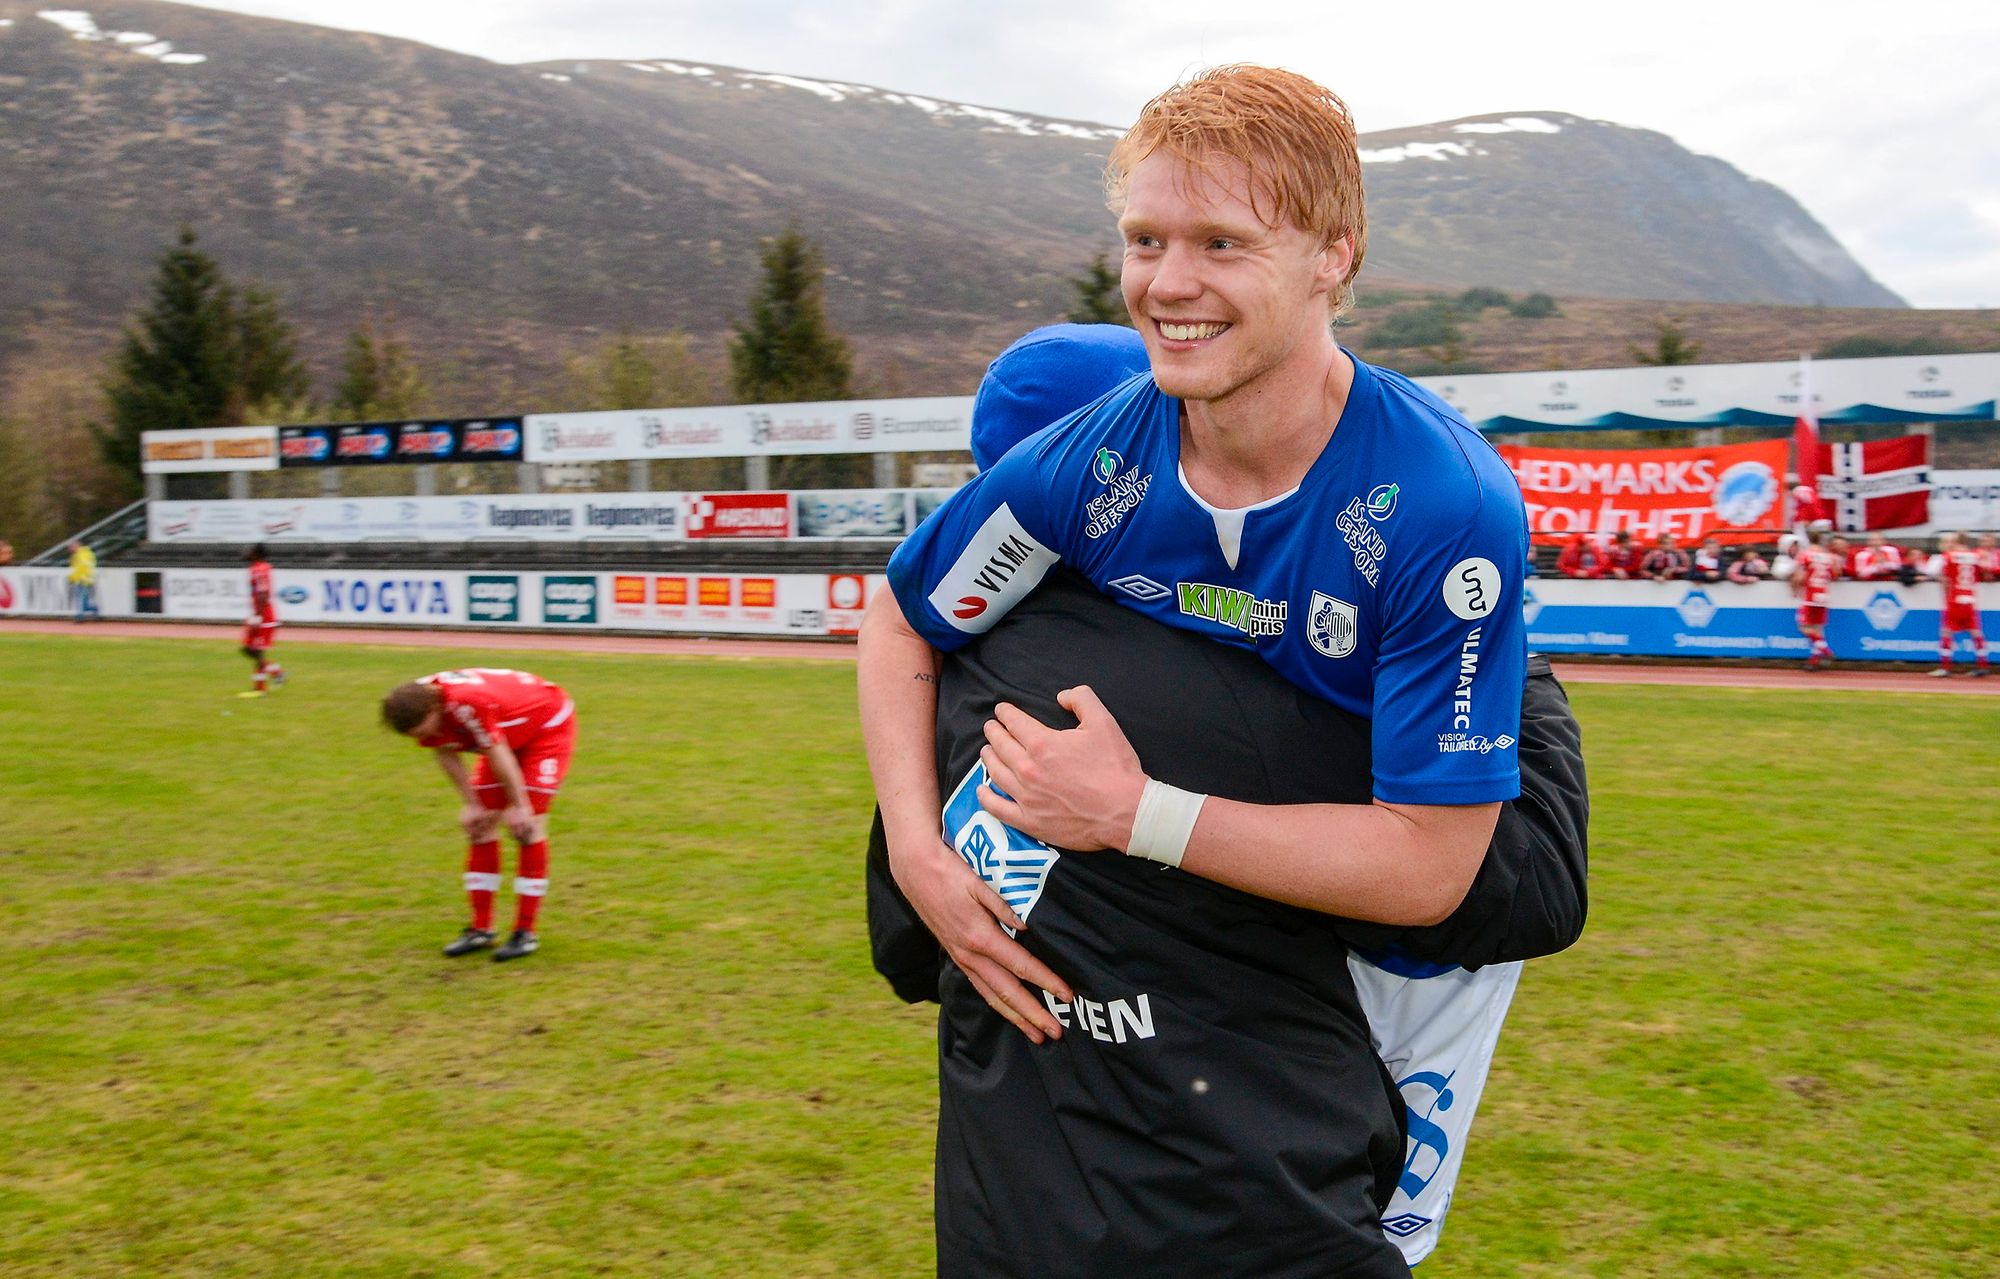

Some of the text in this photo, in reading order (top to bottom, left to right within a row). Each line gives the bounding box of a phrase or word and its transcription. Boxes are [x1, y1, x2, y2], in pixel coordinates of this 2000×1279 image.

[1504, 456, 1716, 495] HEDMARKS
[973, 534, 1034, 593] VISMA
[323, 579, 450, 614] NOGVA
[1178, 583, 1254, 632] KIWI
[1251, 599, 1287, 620] mini
[1250, 618, 1284, 638] pris
[1438, 733, 1467, 742] VISION
